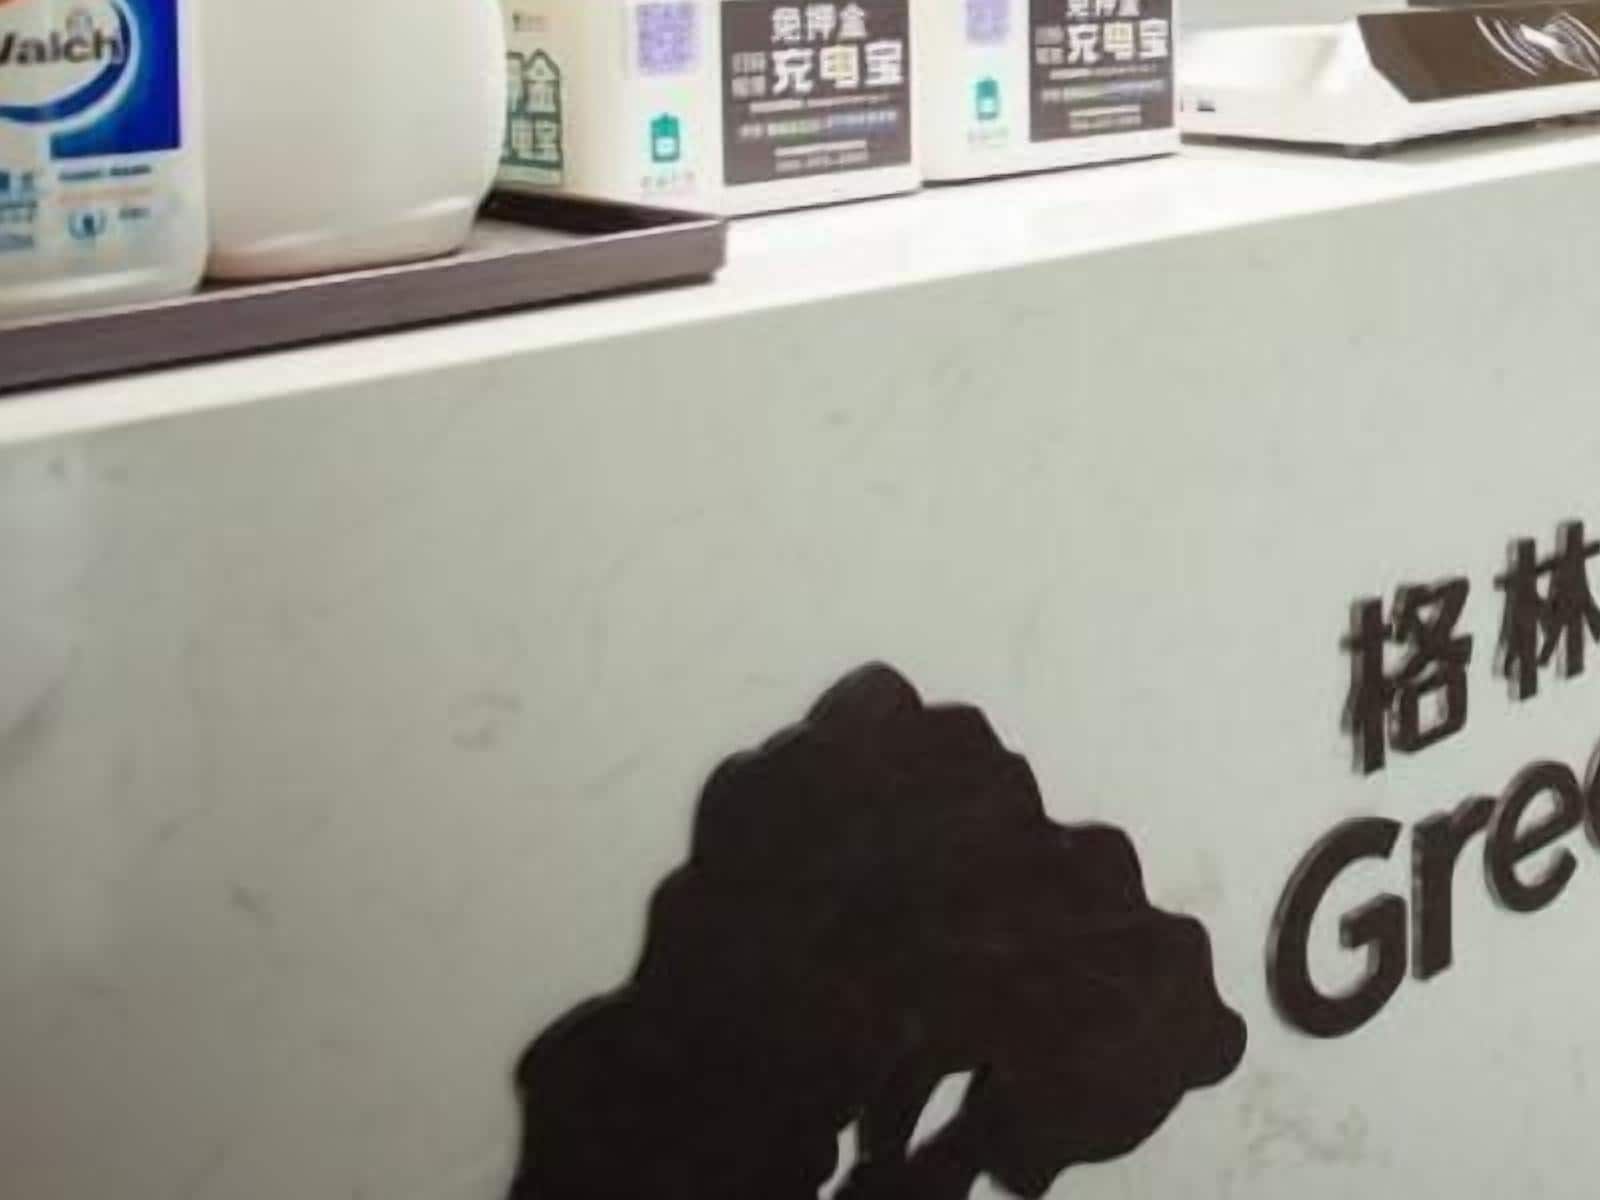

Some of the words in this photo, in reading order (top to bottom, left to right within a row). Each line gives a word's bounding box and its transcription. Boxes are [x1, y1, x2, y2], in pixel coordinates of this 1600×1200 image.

[770, 3, 868, 44] 免押金
[1066, 17, 1169, 65] 充电宝
[771, 40, 904, 96] 充电宝
